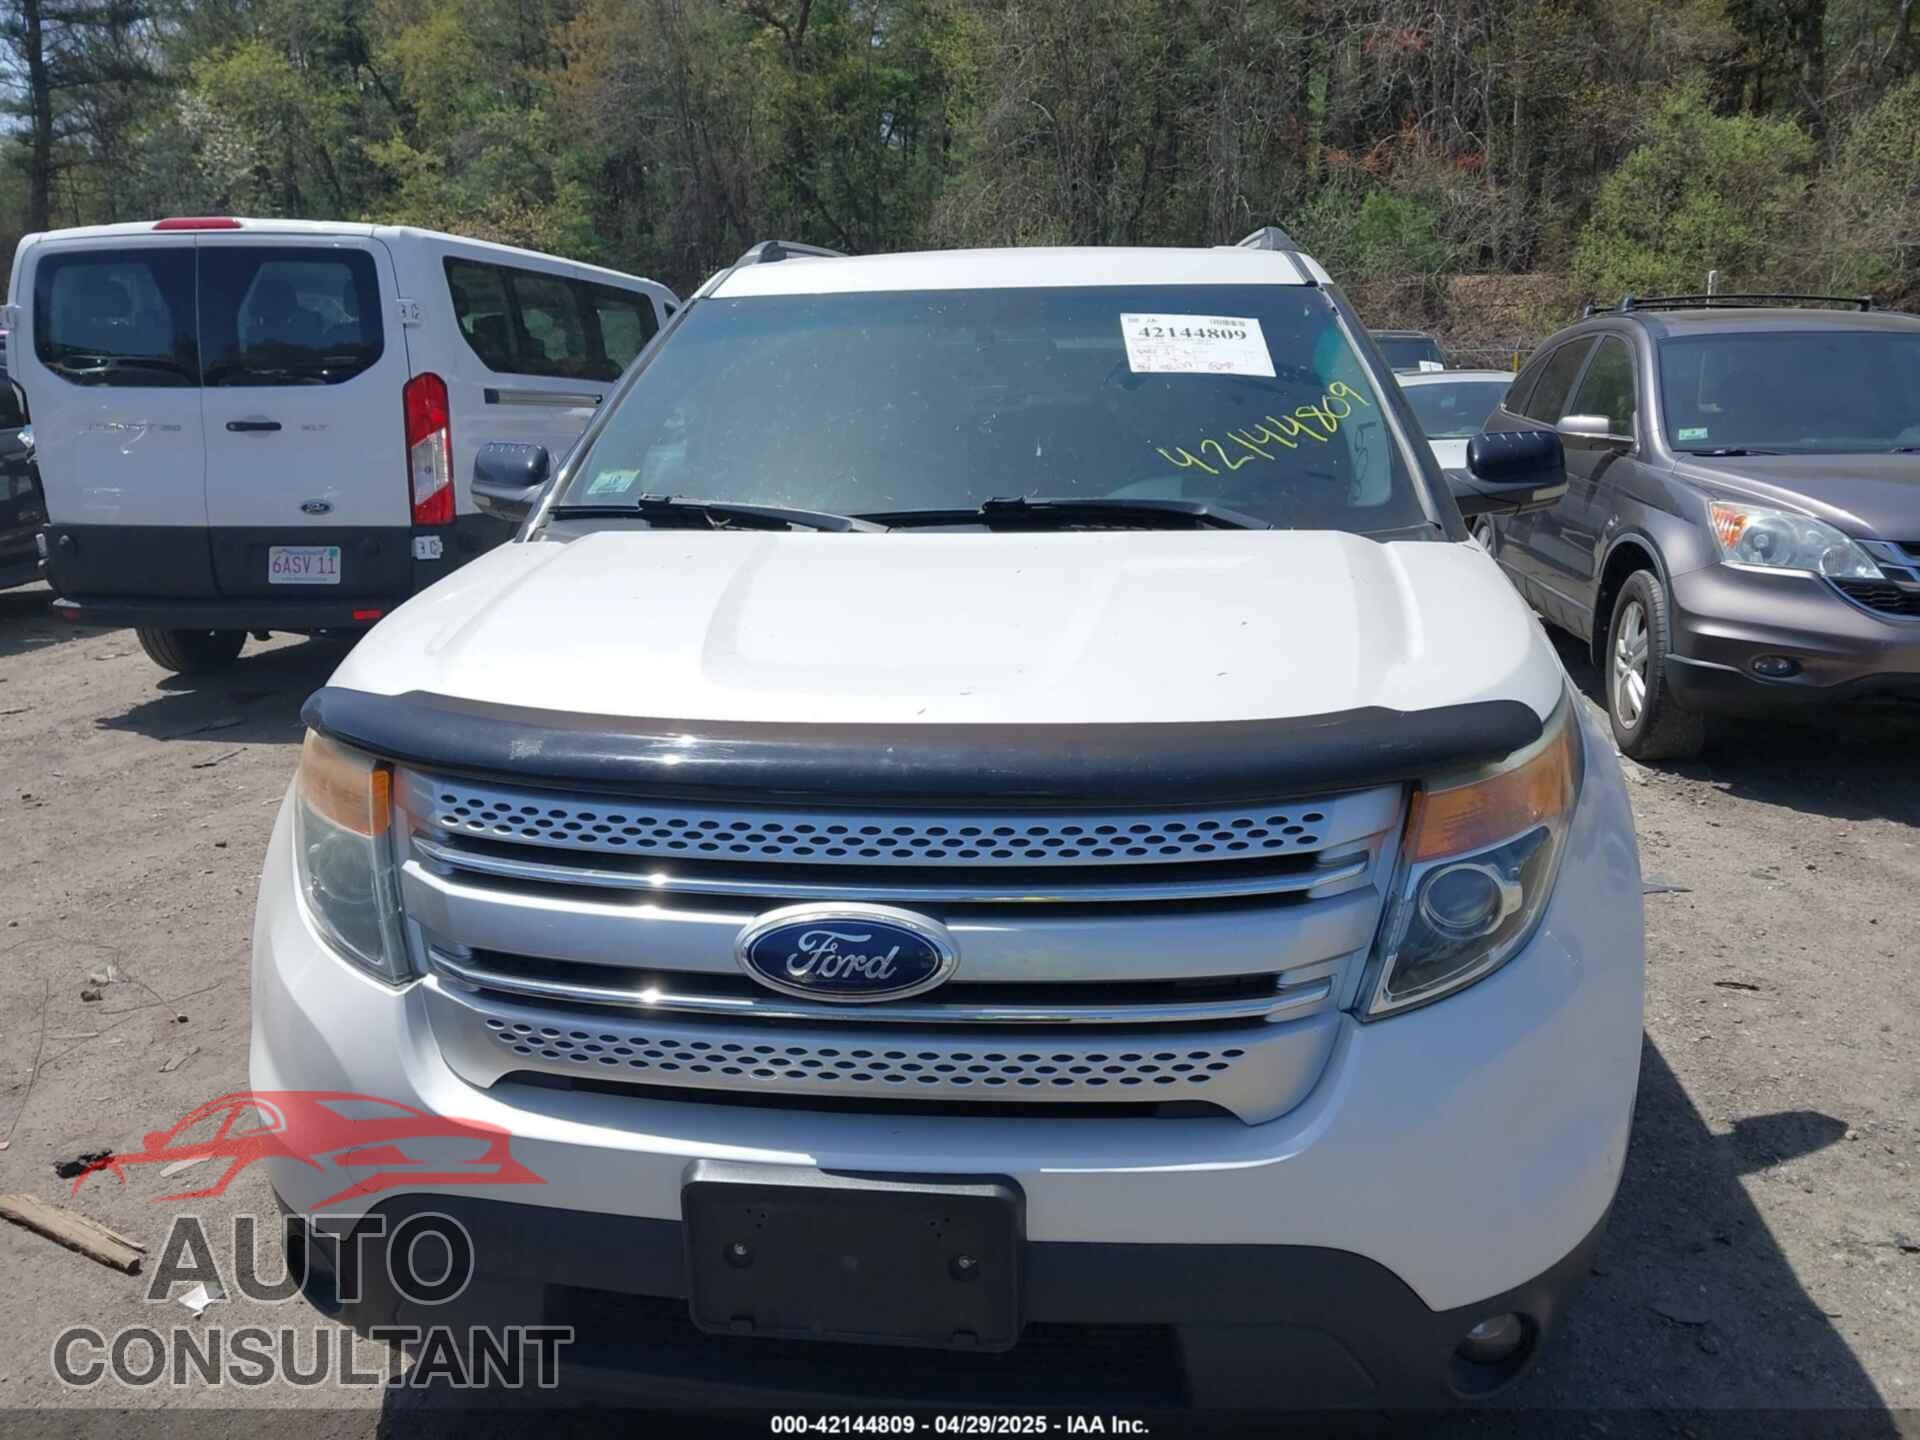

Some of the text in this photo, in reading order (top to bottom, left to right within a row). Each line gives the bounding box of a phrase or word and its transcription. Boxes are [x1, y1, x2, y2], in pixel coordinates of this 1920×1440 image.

[1138, 327, 1247, 340] 42144809
[1156, 382, 1370, 474] 42144809
[272, 556, 336, 574] 6ASV 11
[786, 930, 900, 979] Ford
